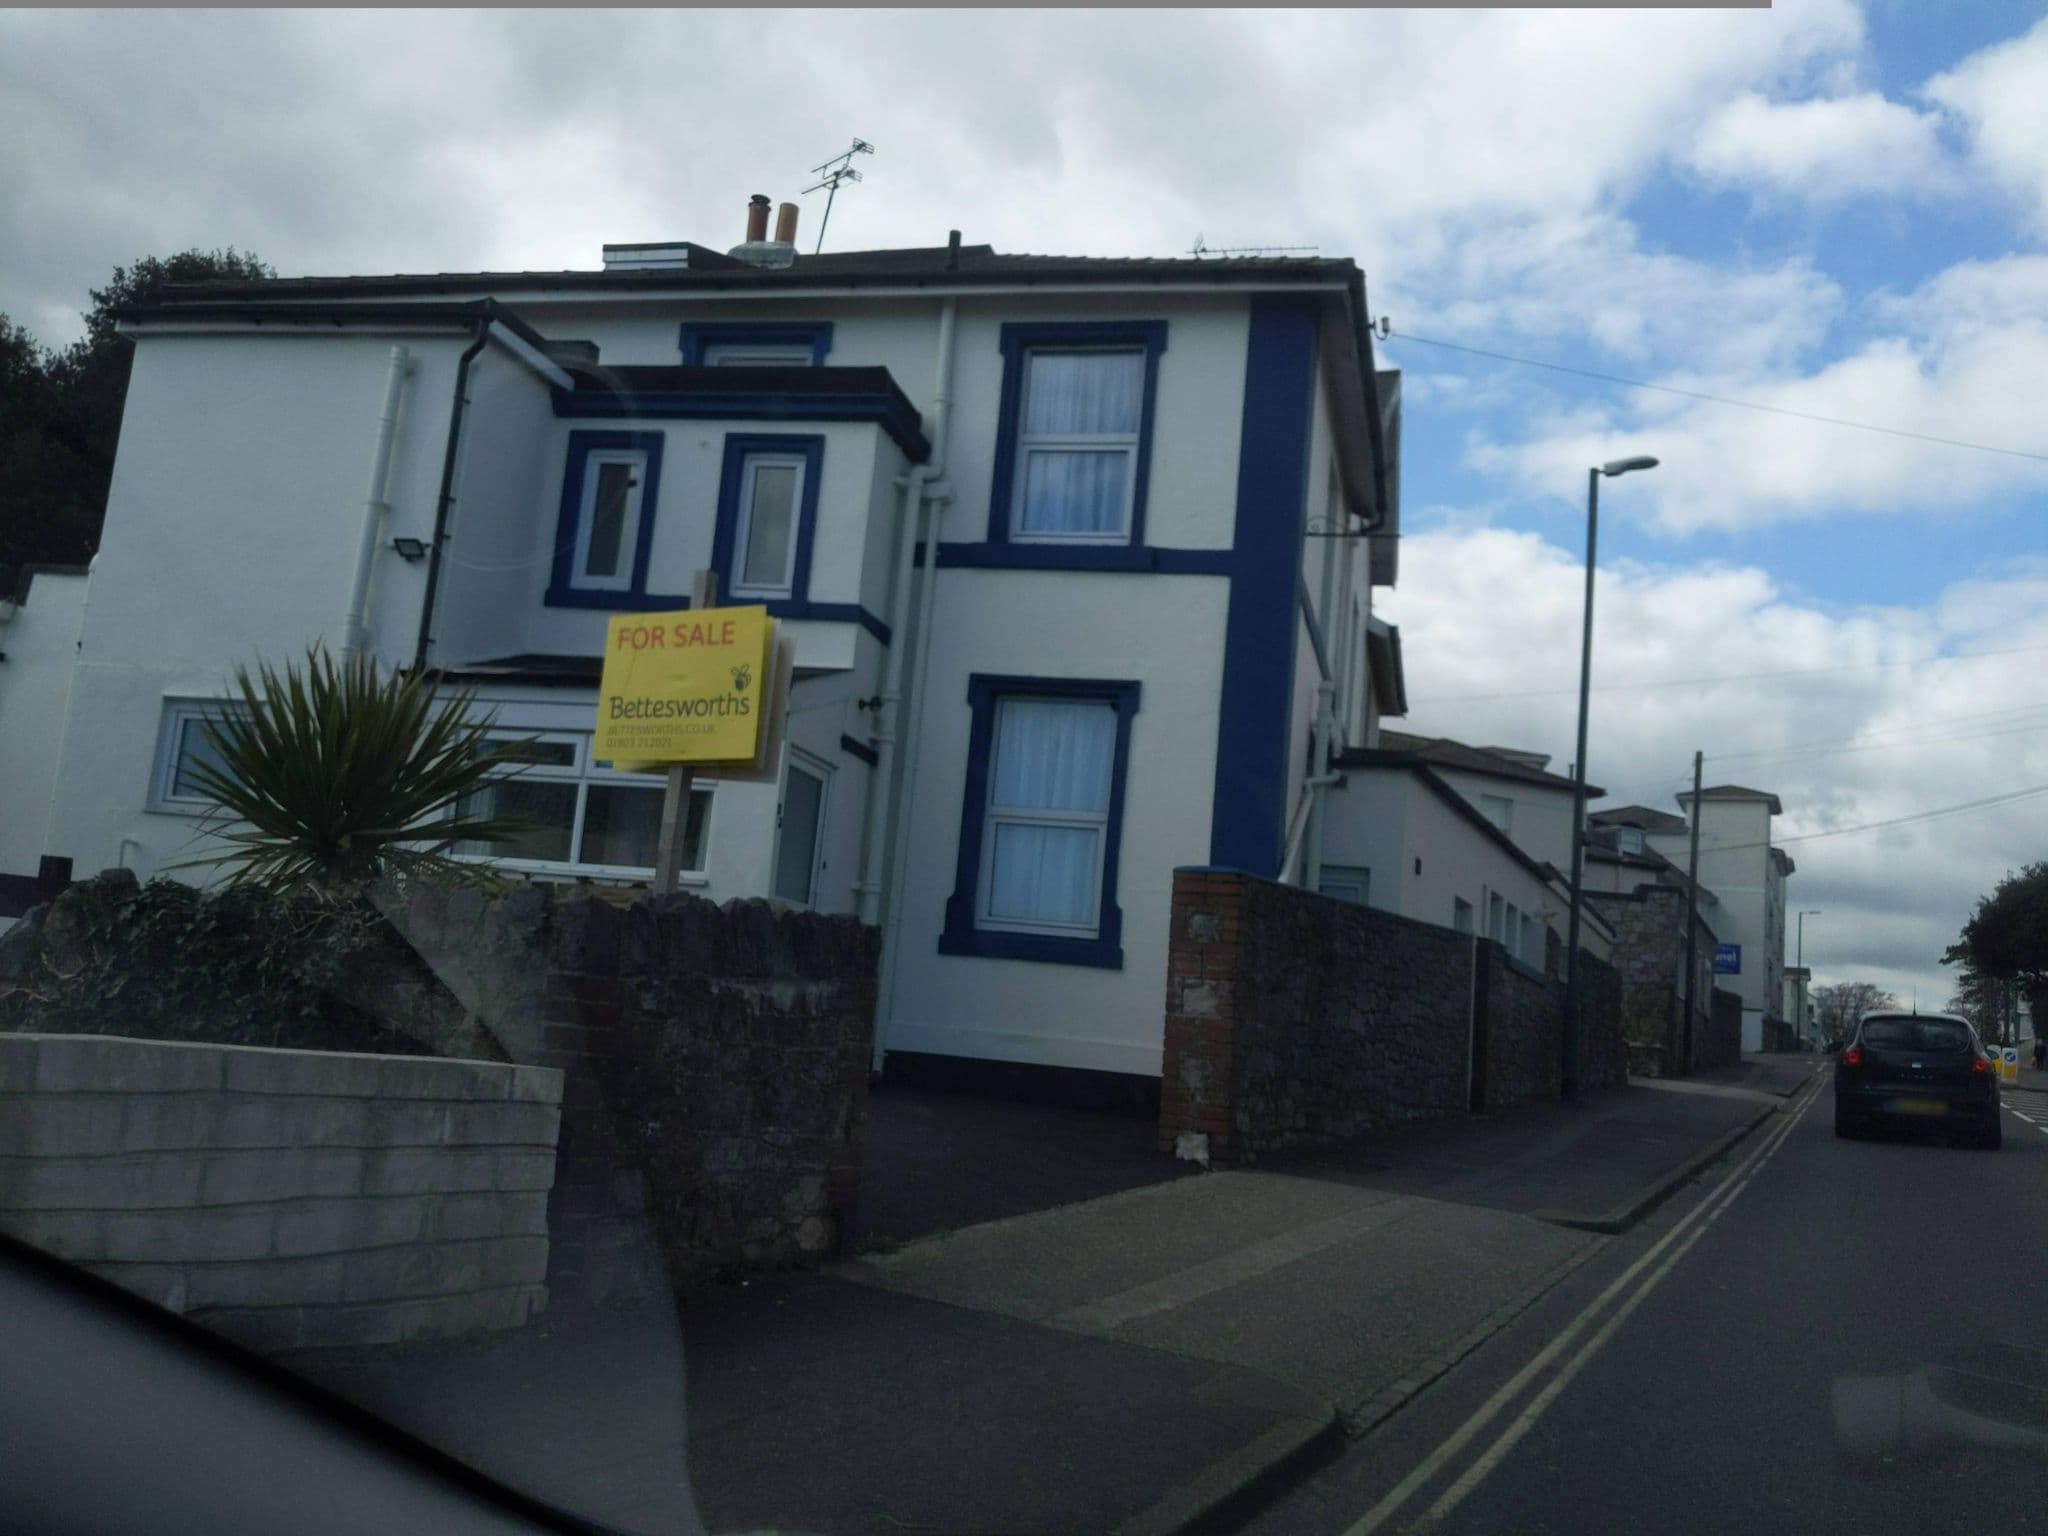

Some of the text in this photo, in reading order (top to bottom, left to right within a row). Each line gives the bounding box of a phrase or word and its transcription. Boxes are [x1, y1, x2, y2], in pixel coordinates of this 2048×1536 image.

[617, 621, 735, 650] FOR SALE
[609, 692, 749, 719] Bettesworths
